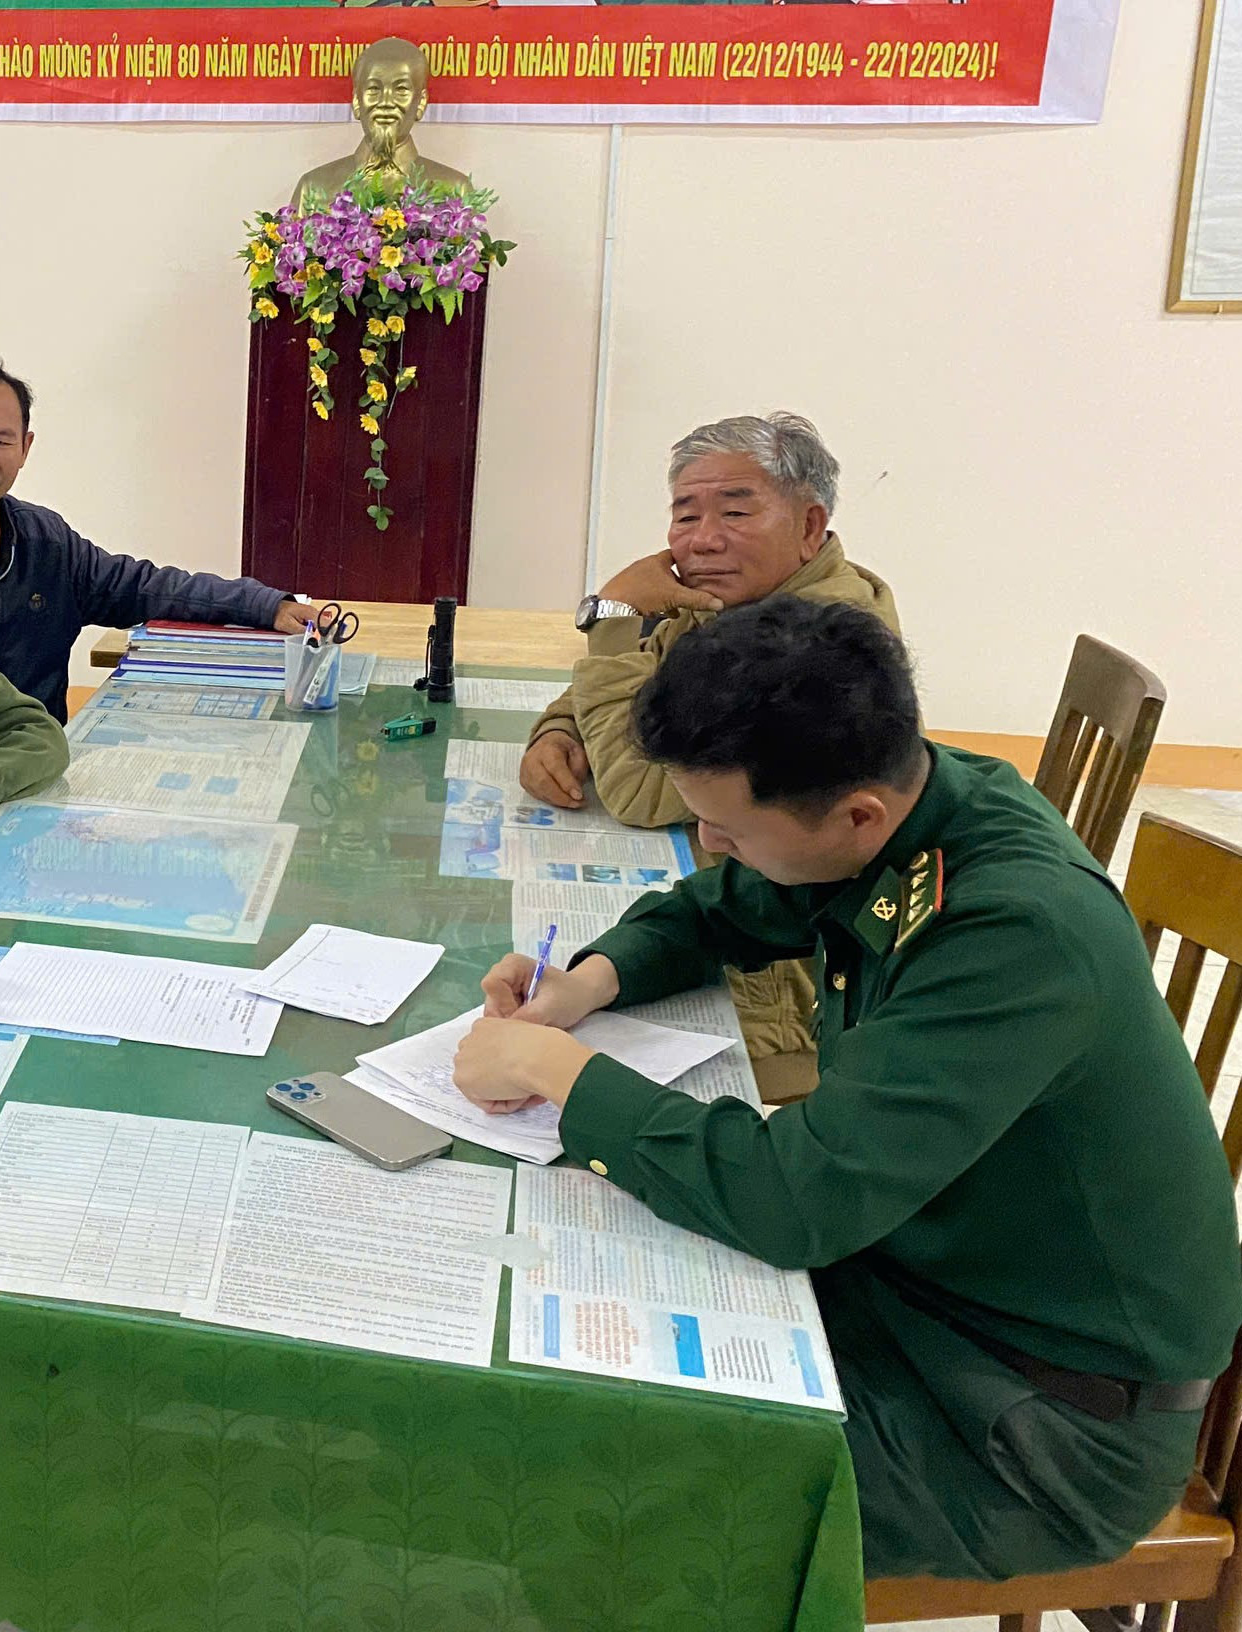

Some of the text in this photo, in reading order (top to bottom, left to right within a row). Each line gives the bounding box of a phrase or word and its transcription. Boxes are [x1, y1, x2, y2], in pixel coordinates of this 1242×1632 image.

[39, 37, 92, 78] MỪNG
[96, 32, 120, 78] KỶ
[124, 36, 173, 86] NIỆM
[177, 43, 200, 78] 80
[204, 36, 248, 78] NĂM
[253, 36, 304, 78] NGÀY
[309, 36, 371, 78] THÀN
[475, 35, 509, 85] ĐỘI
[513, 35, 570, 78] NHÂN
[574, 35, 617, 78] DÂN
[622, 35, 665, 86] VIỆT
[668, 42, 718, 78] NAM
[723, 41, 844, 81] (22/12/1944
[850, 58, 859, 67] -
[863, 41, 999, 82] 22/12/2024)!
